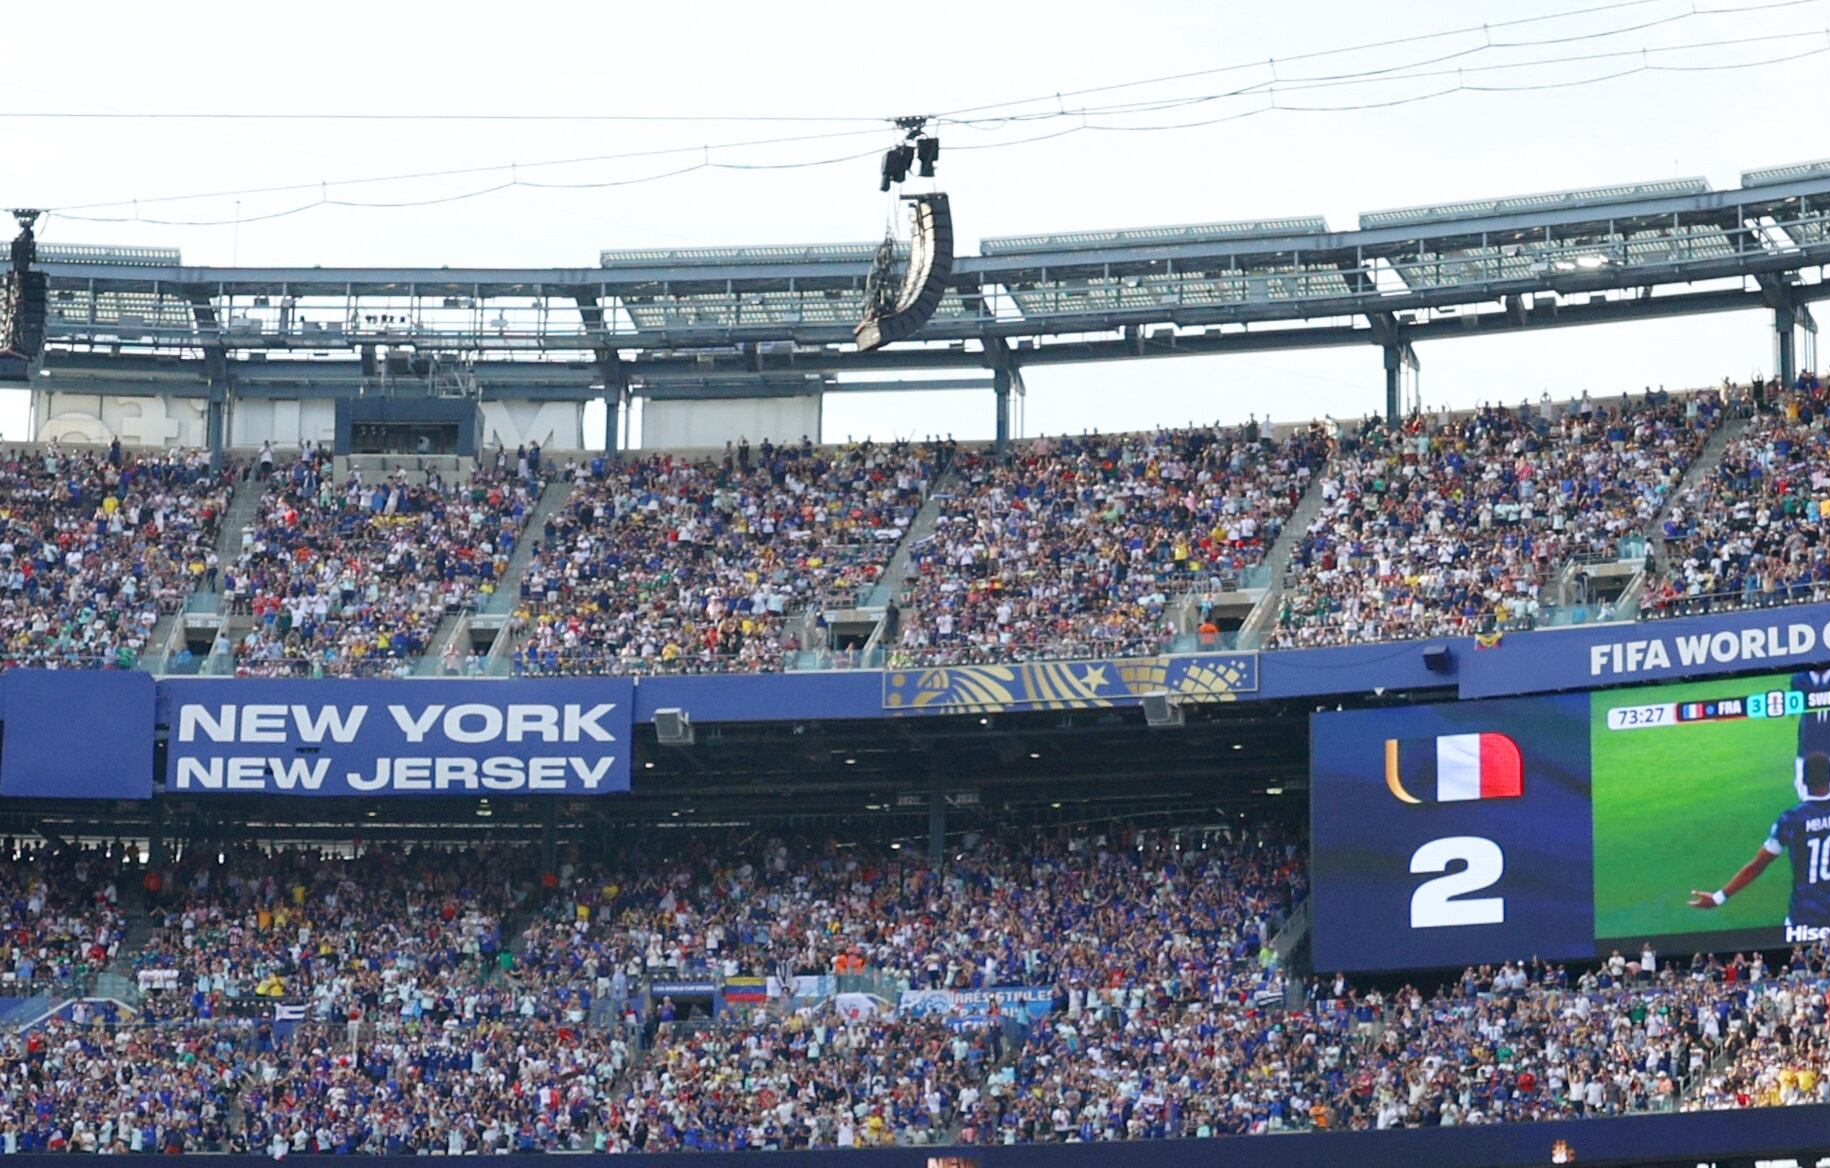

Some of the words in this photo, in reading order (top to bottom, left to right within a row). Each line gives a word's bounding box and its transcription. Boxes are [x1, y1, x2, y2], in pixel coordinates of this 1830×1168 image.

[1590, 640, 1671, 676] FIFA
[1676, 624, 1816, 667] WORLD
[179, 704, 368, 742] NEW
[388, 704, 616, 743] YORK
[1618, 708, 1665, 725] 73:27
[1718, 700, 1742, 715] FRA
[1752, 699, 1761, 713] 3
[1789, 695, 1799, 709] 0
[177, 757, 331, 789] NEW
[347, 756, 615, 791] JERSEY
[1410, 836, 1504, 928] 2
